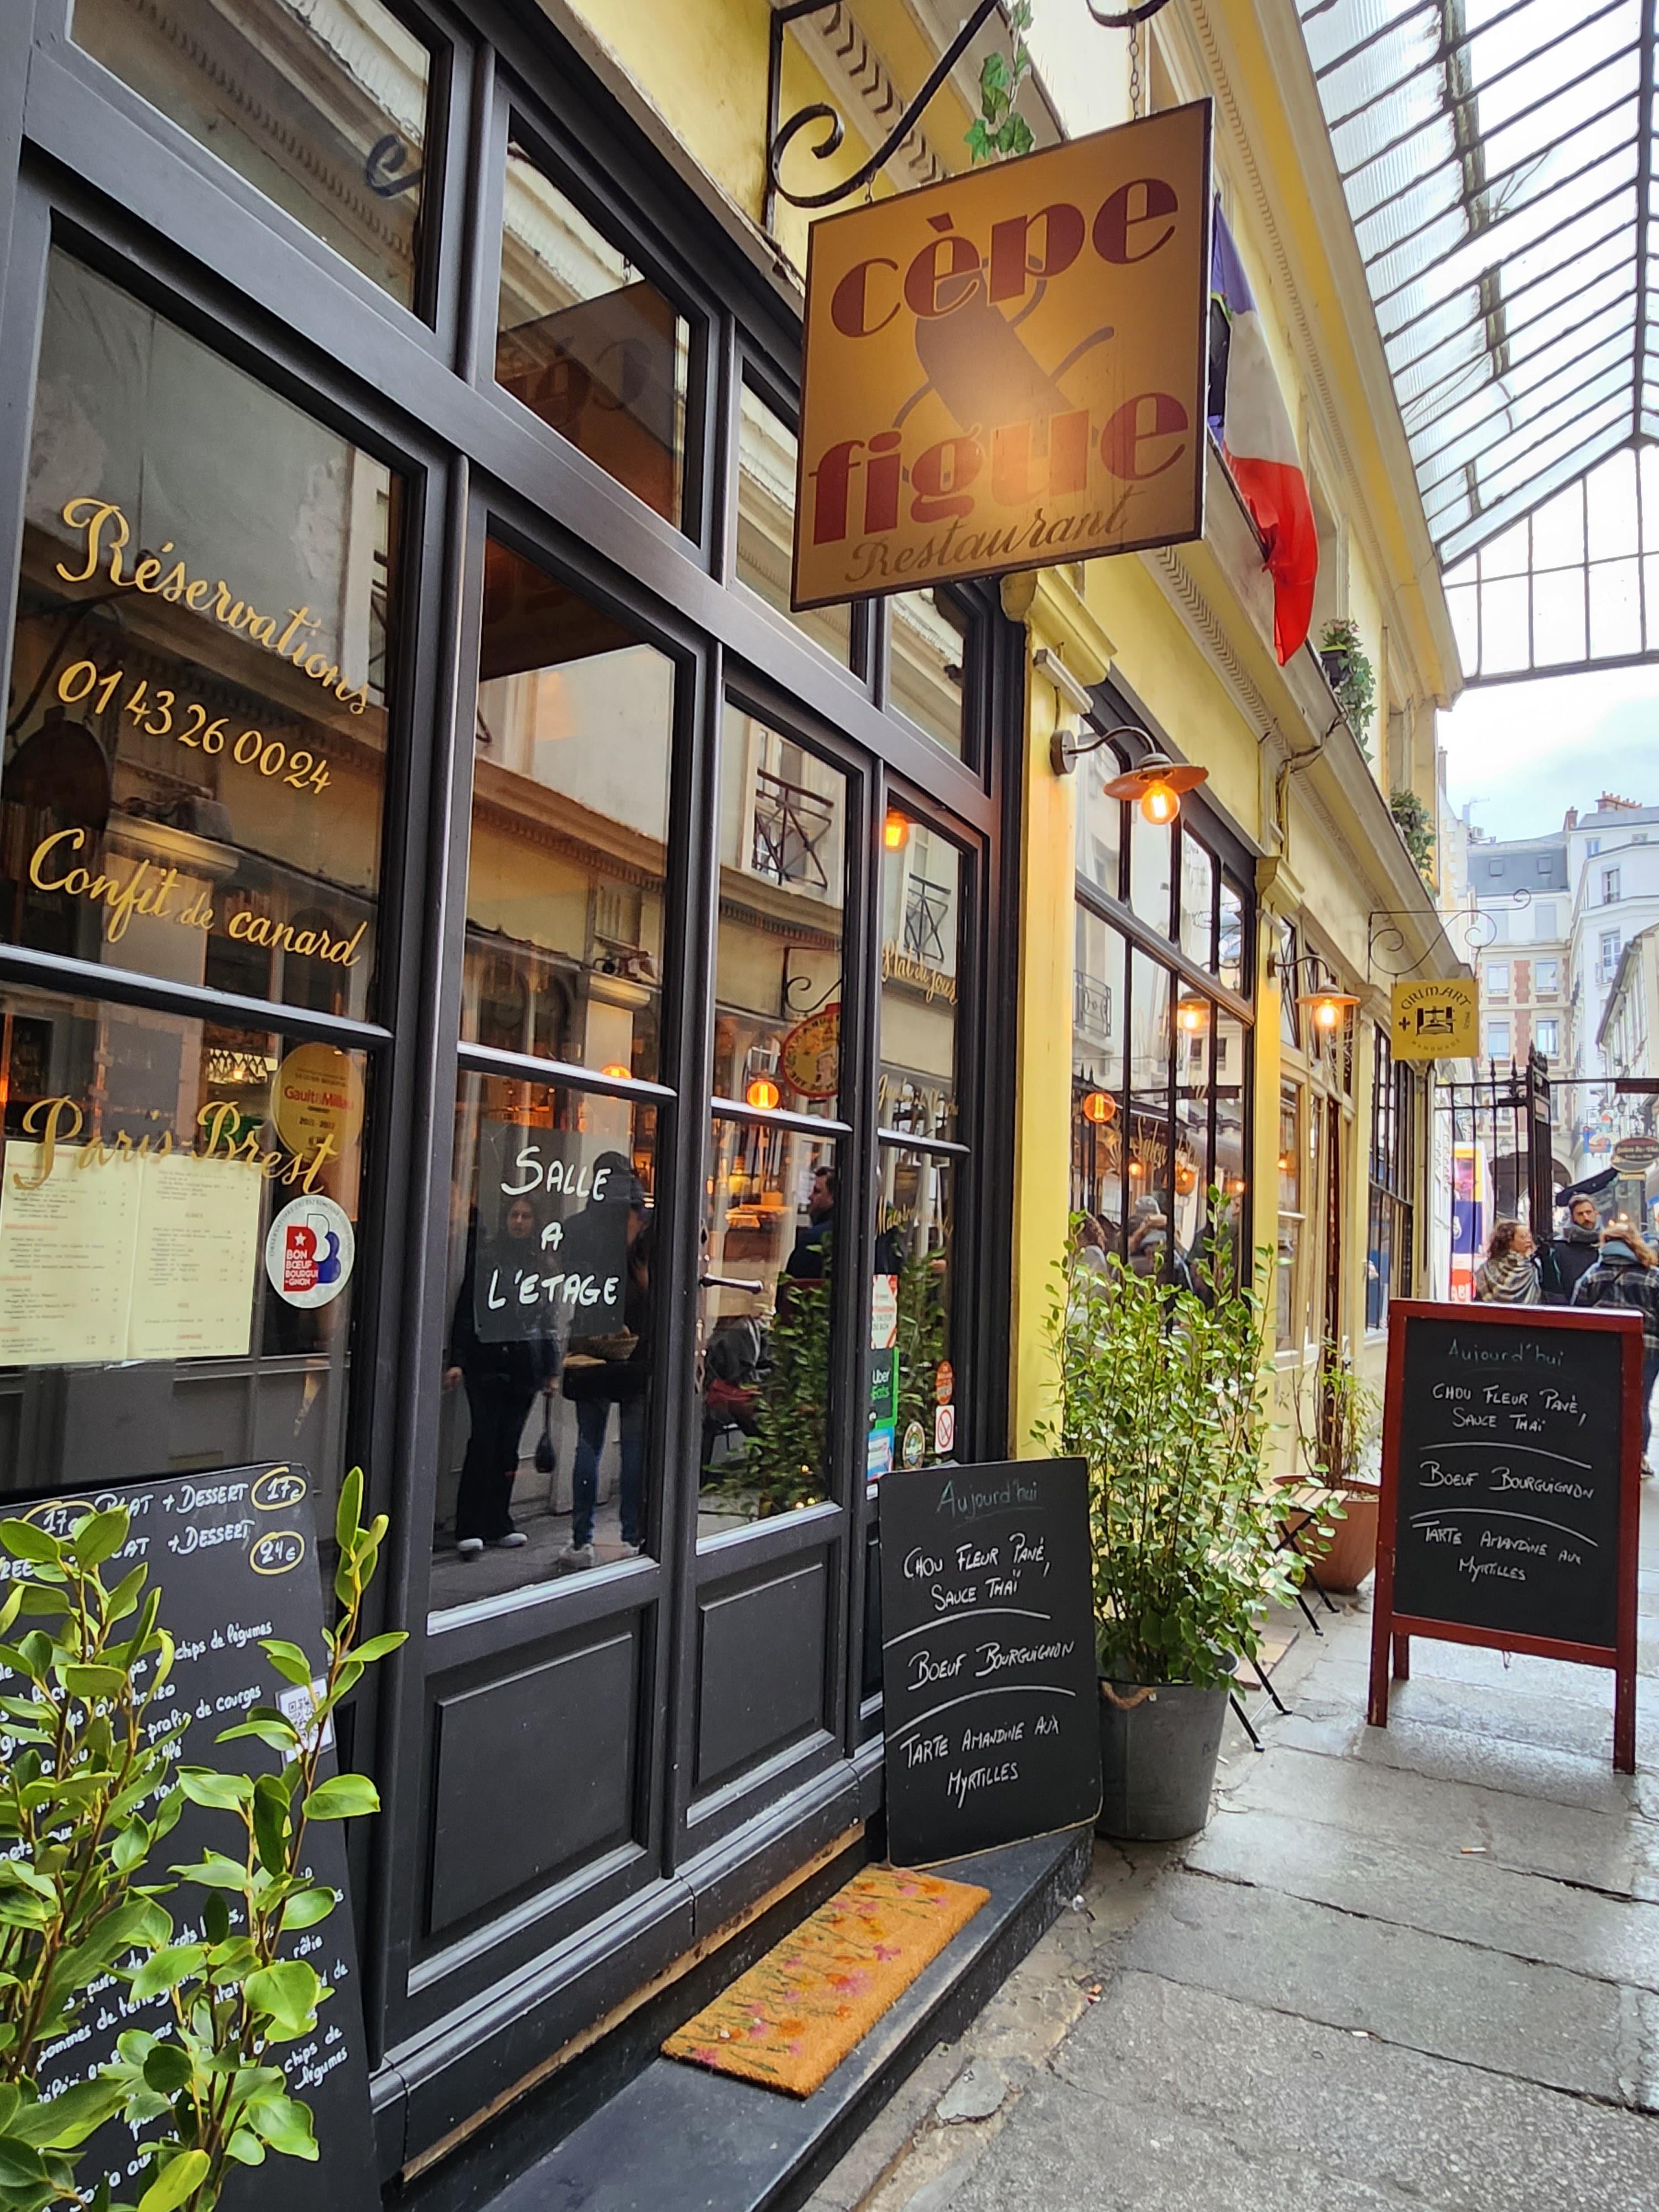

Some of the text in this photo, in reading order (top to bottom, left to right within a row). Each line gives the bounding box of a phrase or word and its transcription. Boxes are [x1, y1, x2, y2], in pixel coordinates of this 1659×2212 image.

[831, 178, 1180, 338] cèpe
[808, 392, 1189, 545] figue
[844, 485, 1146, 582] Restaurant
[56, 497, 371, 716] Réservations
[29, 828, 367, 968] Confit de canard
[881, 937, 914, 982] Plat
[501, 1145, 611, 1201] SALLE
[286, 1249, 307, 1260] BON
[541, 1221, 564, 1251] A
[488, 1269, 619, 1310] L'ETAGE
[871, 1386, 890, 1401] Eats
[872, 1369, 890, 1384] Uber
[1452, 1407, 1497, 1428] SAUCE
[1419, 1460, 1479, 1486] BOEUF
[1412, 1520, 1462, 1545] TARTE
[931, 1584, 977, 1611] SAUCE
[174, 1641, 207, 1661] chips
[210, 1629, 226, 1649] de
[227, 1621, 273, 1648] légumes
[907, 1650, 967, 1691] BOEUF
[195, 1698, 212, 1719] de
[216, 1685, 262, 1709] courges
[899, 1733, 948, 1769] TARTE
[1034, 1714, 1060, 1735] AUX
[96, 2007, 118, 2030] de
[284, 2025, 343, 2073] chips de
